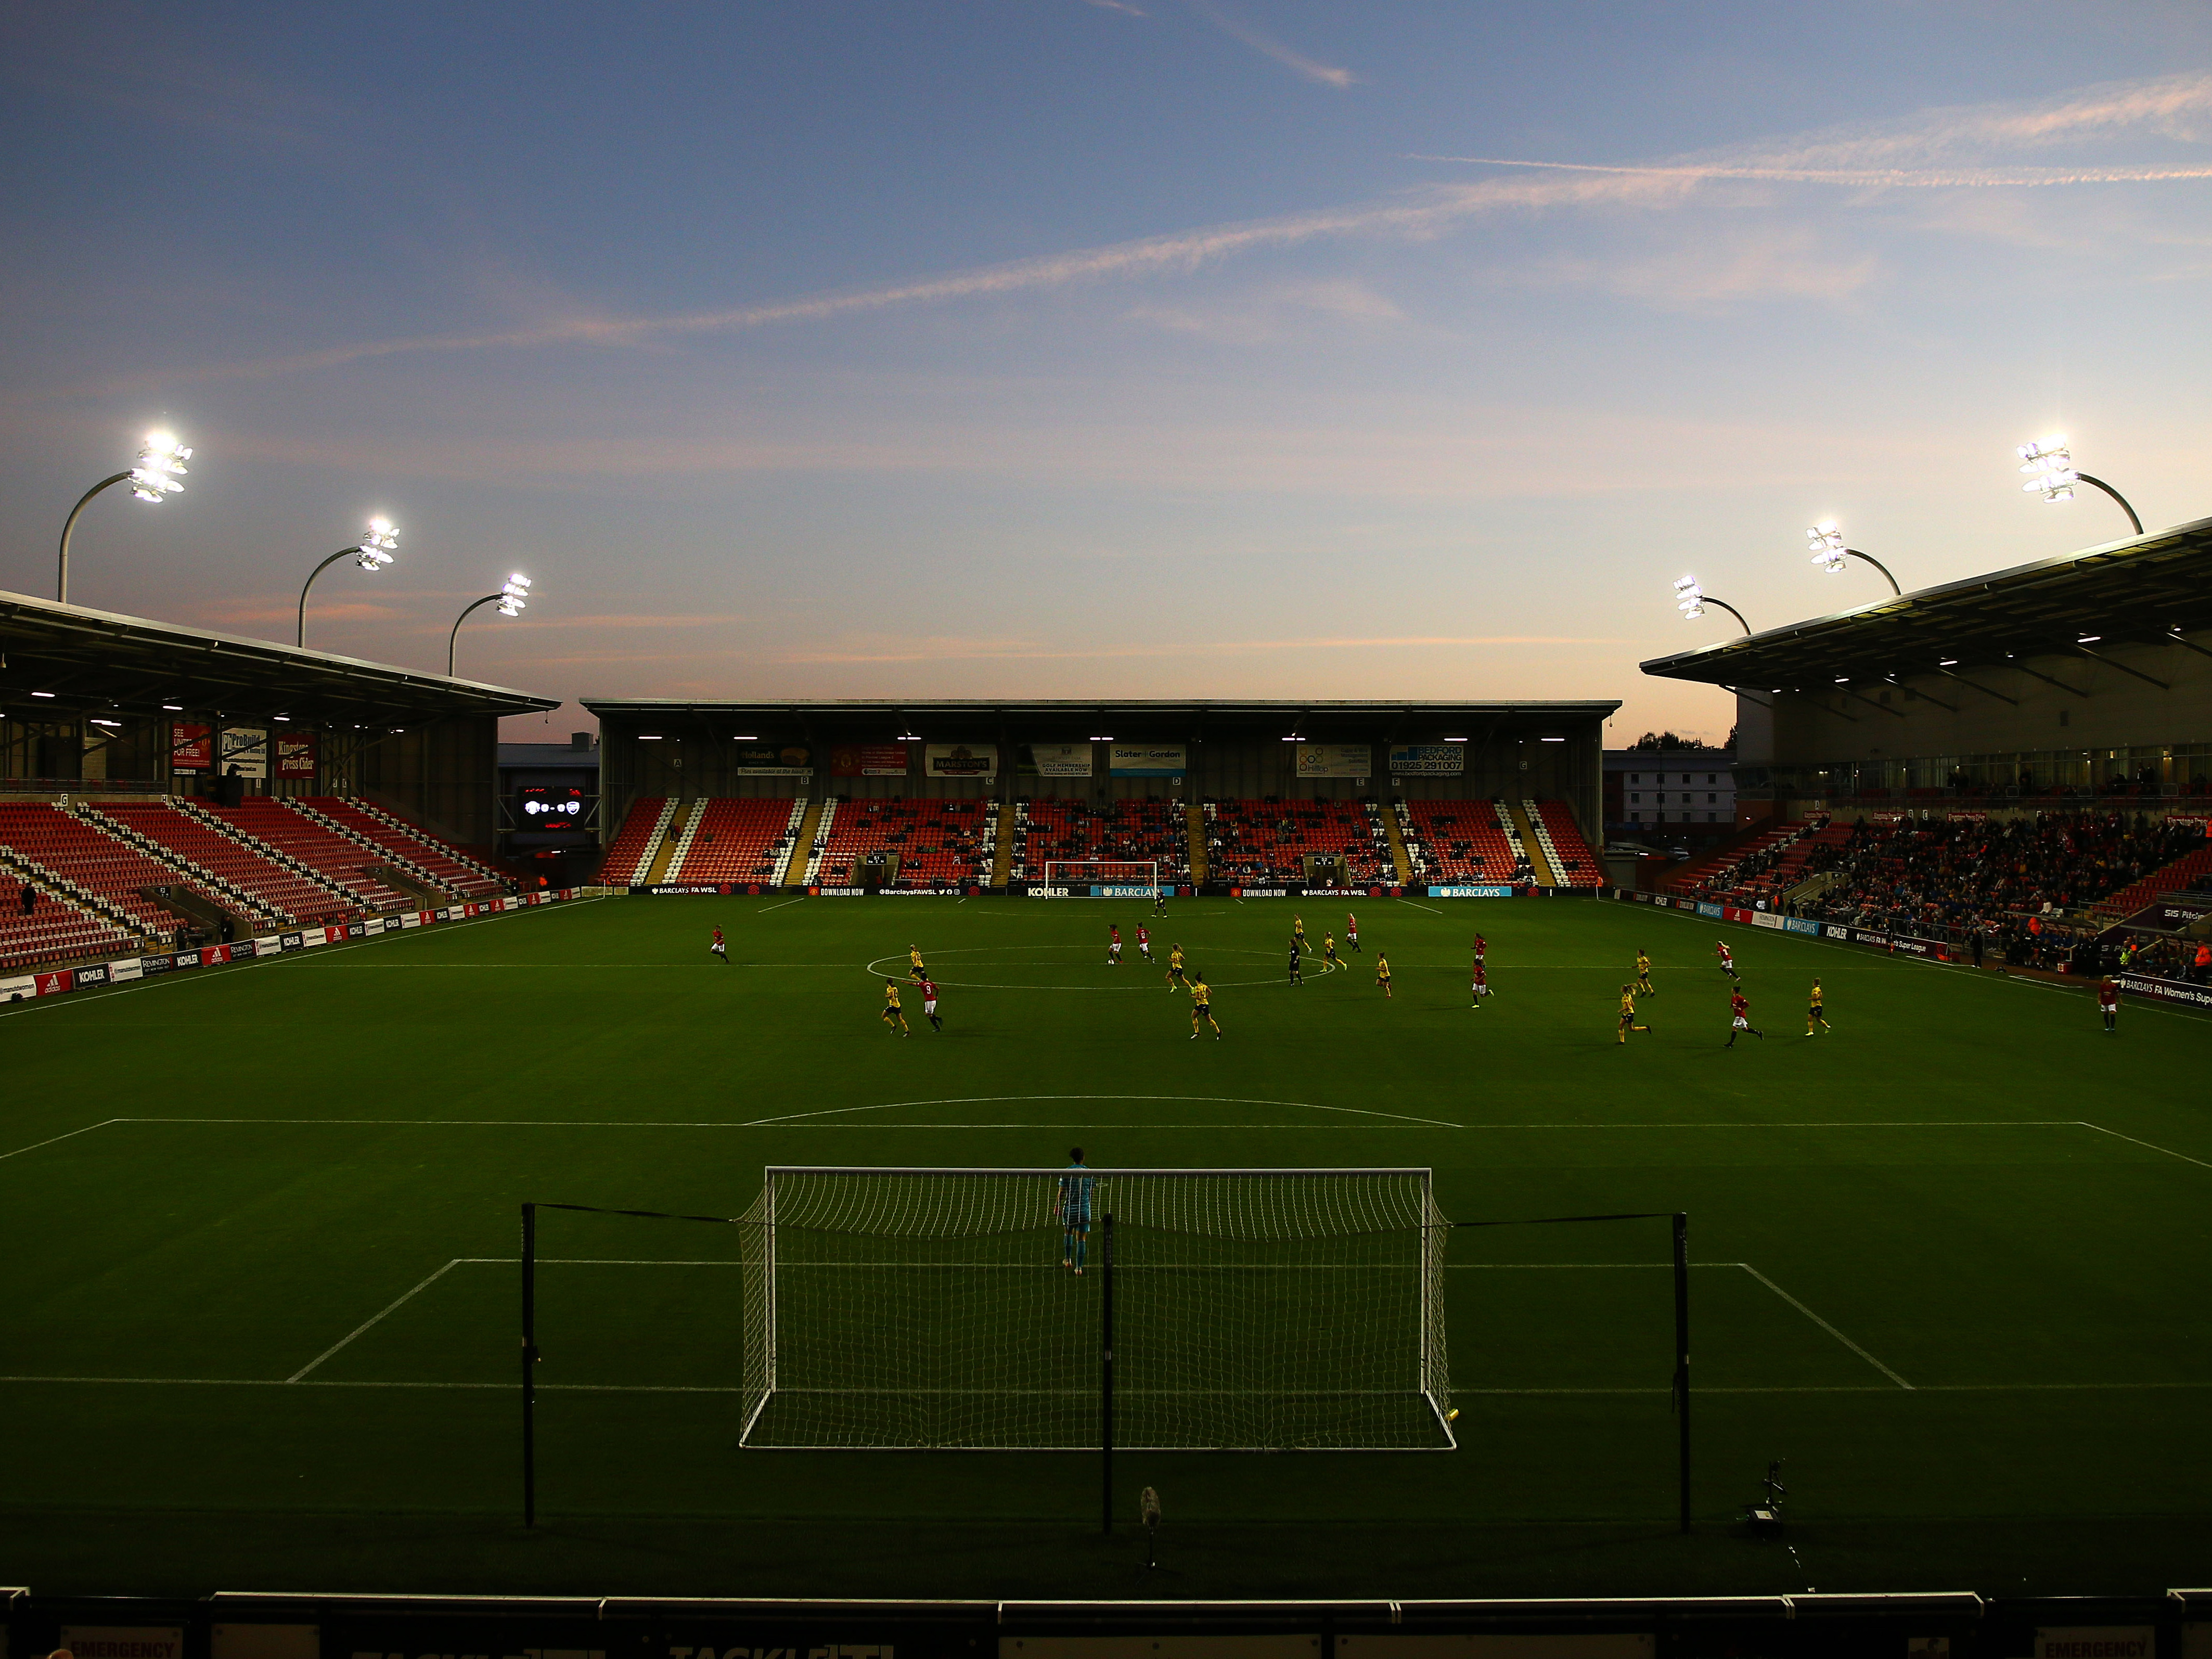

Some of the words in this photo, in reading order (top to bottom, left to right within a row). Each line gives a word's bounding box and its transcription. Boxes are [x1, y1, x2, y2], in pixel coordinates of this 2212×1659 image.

[174, 729, 184, 737] SEE
[186, 749, 200, 757] FREE!
[282, 759, 299, 770] Press
[299, 757, 314, 770] Cider
[62, 795, 67, 805] G
[1028, 888, 1069, 896] KOHLER
[1452, 888, 1500, 897] BARCLAYS
[1703, 904, 1720, 916] BARCLAYS
[1791, 919, 1815, 934] BARCLAYS
[1827, 925, 1847, 940] KOHLER
[283, 936, 301, 947] KOHLER
[1860, 933, 1875, 943] BARCLAYS
[1899, 941, 1911, 950] Super
[1911, 943, 1926, 953] League
[143, 958, 170, 968] REMINGTON
[177, 954, 199, 967] KOHLER
[79, 969, 105, 983] KOHLER
[45, 985, 60, 994] adidas
[926, 986, 931, 994] 9
[2126, 980, 2153, 993] BARCLAYS
[2154, 985, 2163, 995] FA
[2164, 986, 2195, 1000] Women's
[2196, 992, 2212, 1006] Supe
[71, 1641, 175, 1658] EMERGENCY
[2045, 1640, 2147, 1658] EMERGENCY
